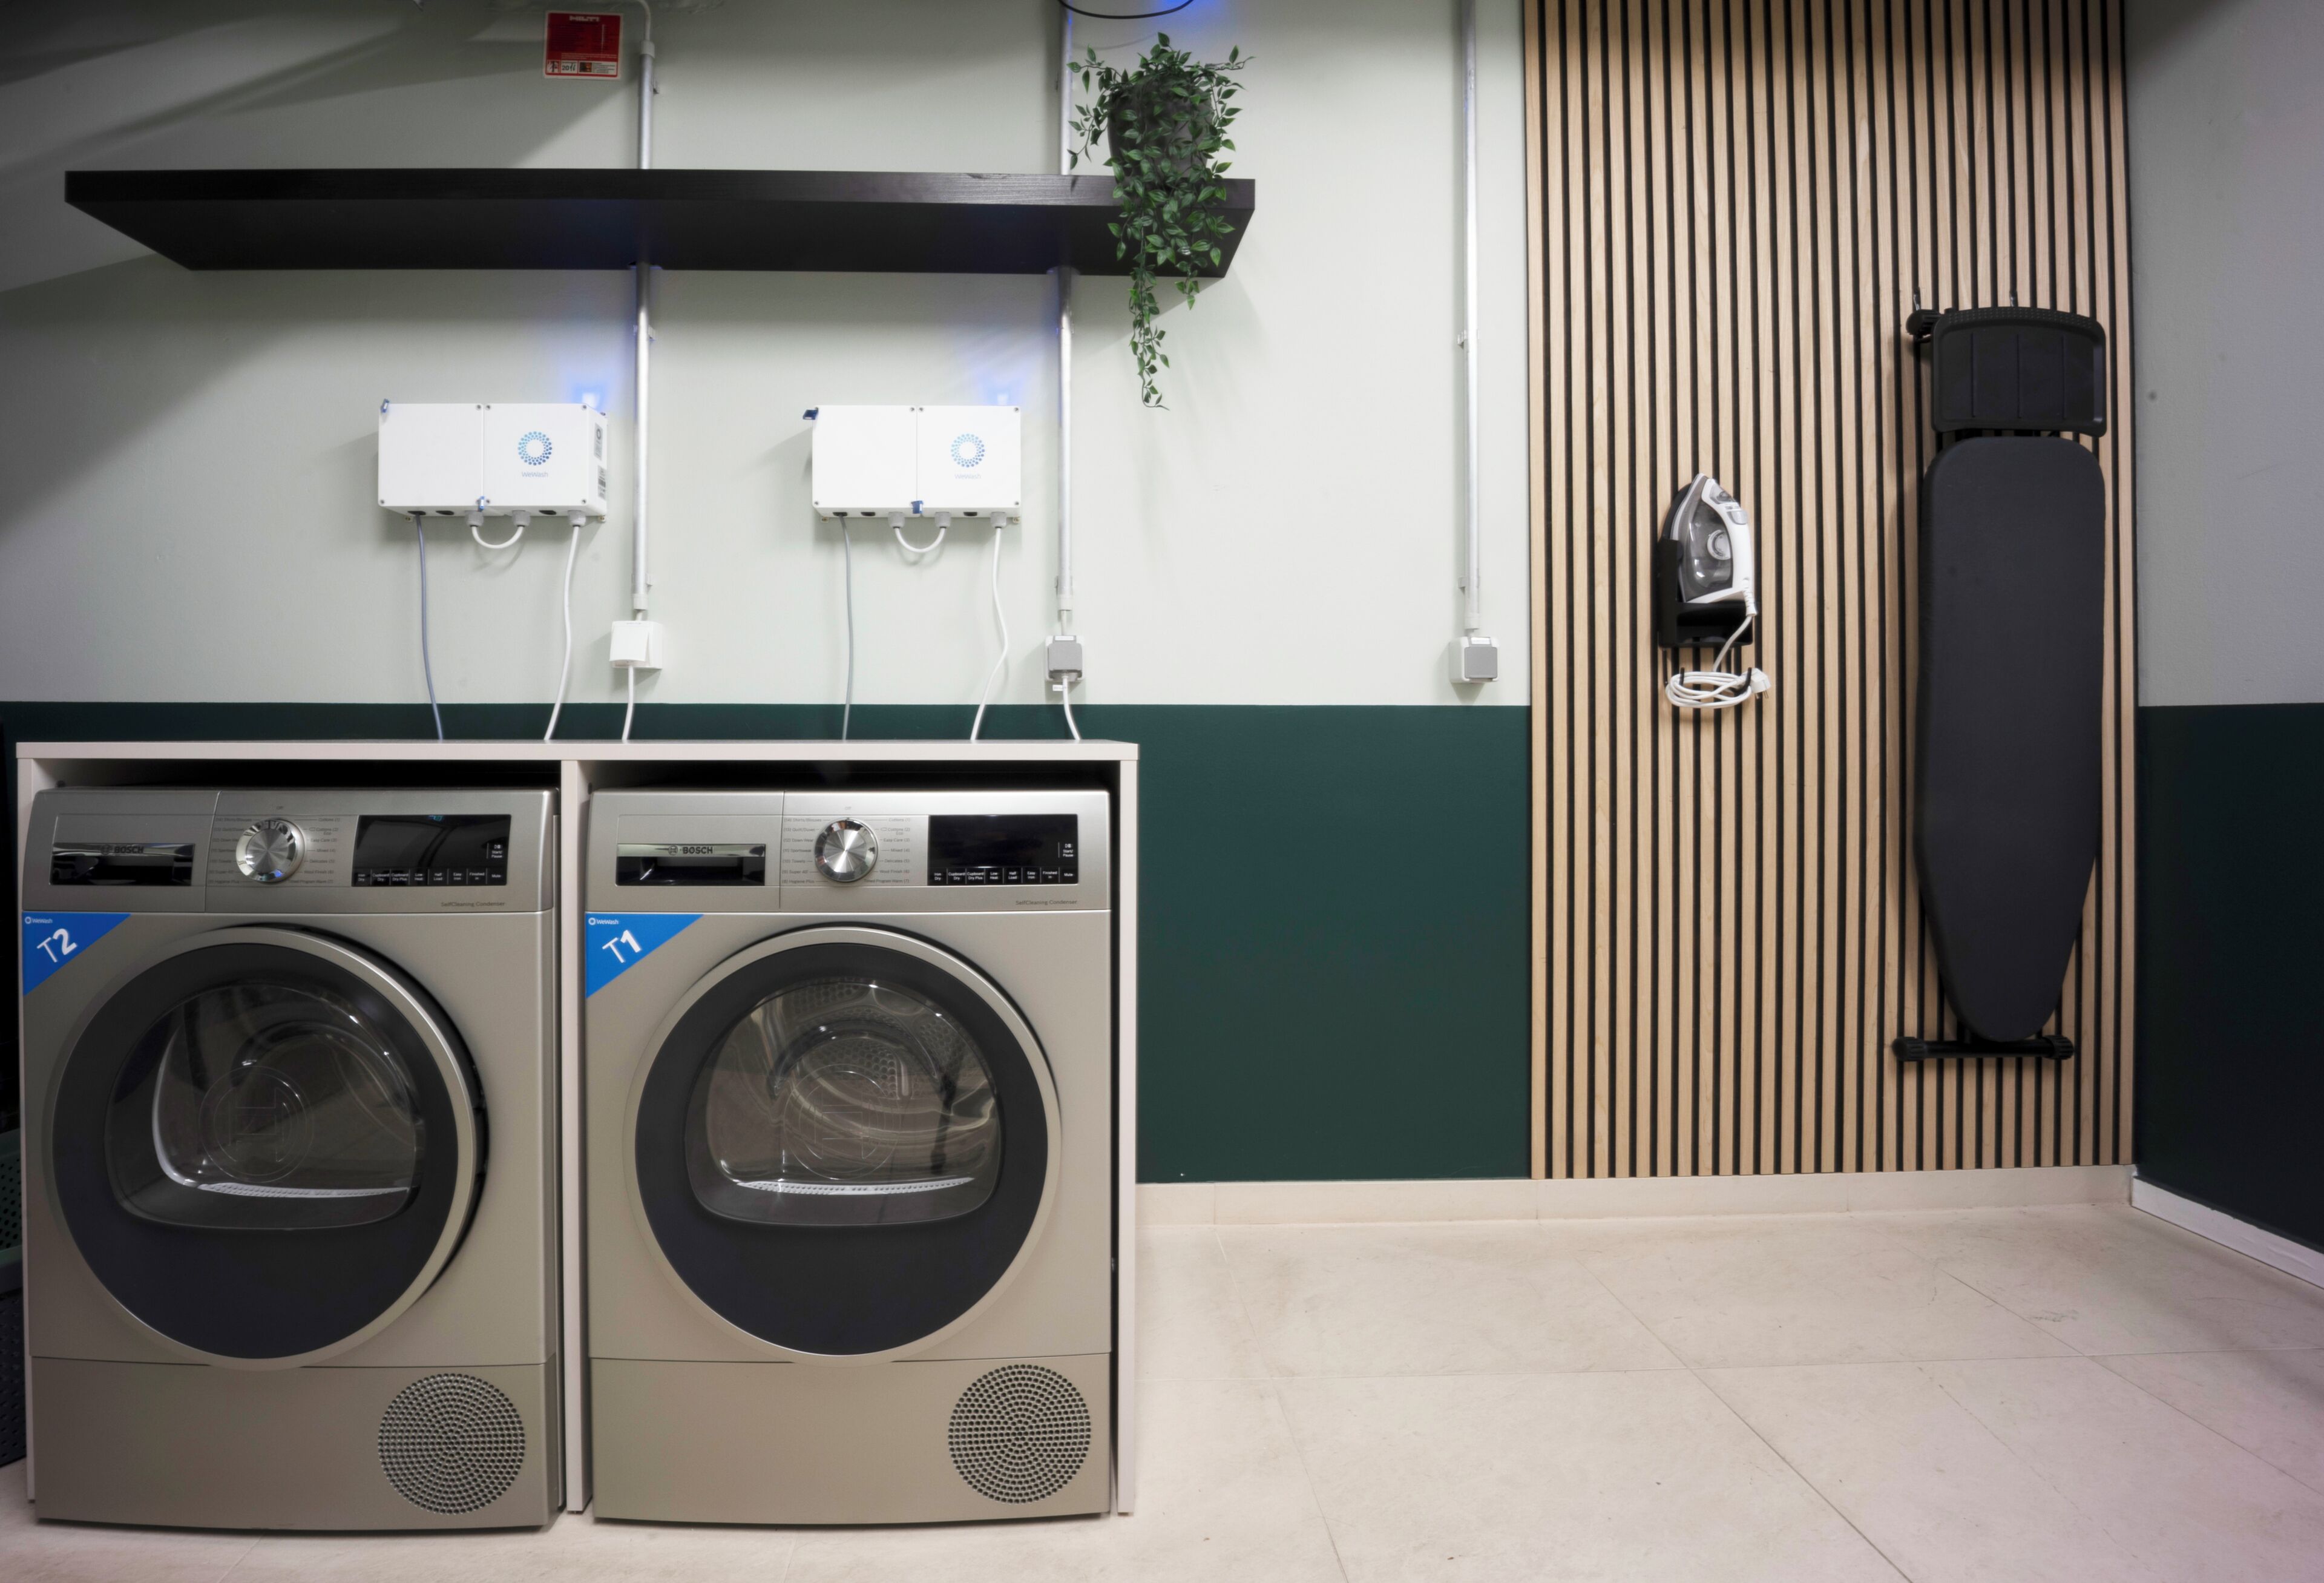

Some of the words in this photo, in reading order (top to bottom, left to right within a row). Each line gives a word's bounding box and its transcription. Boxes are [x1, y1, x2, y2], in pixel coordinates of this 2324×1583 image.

[114, 846, 144, 854] BOSCH
[36, 928, 77, 963] T2
[602, 929, 642, 963] T1
